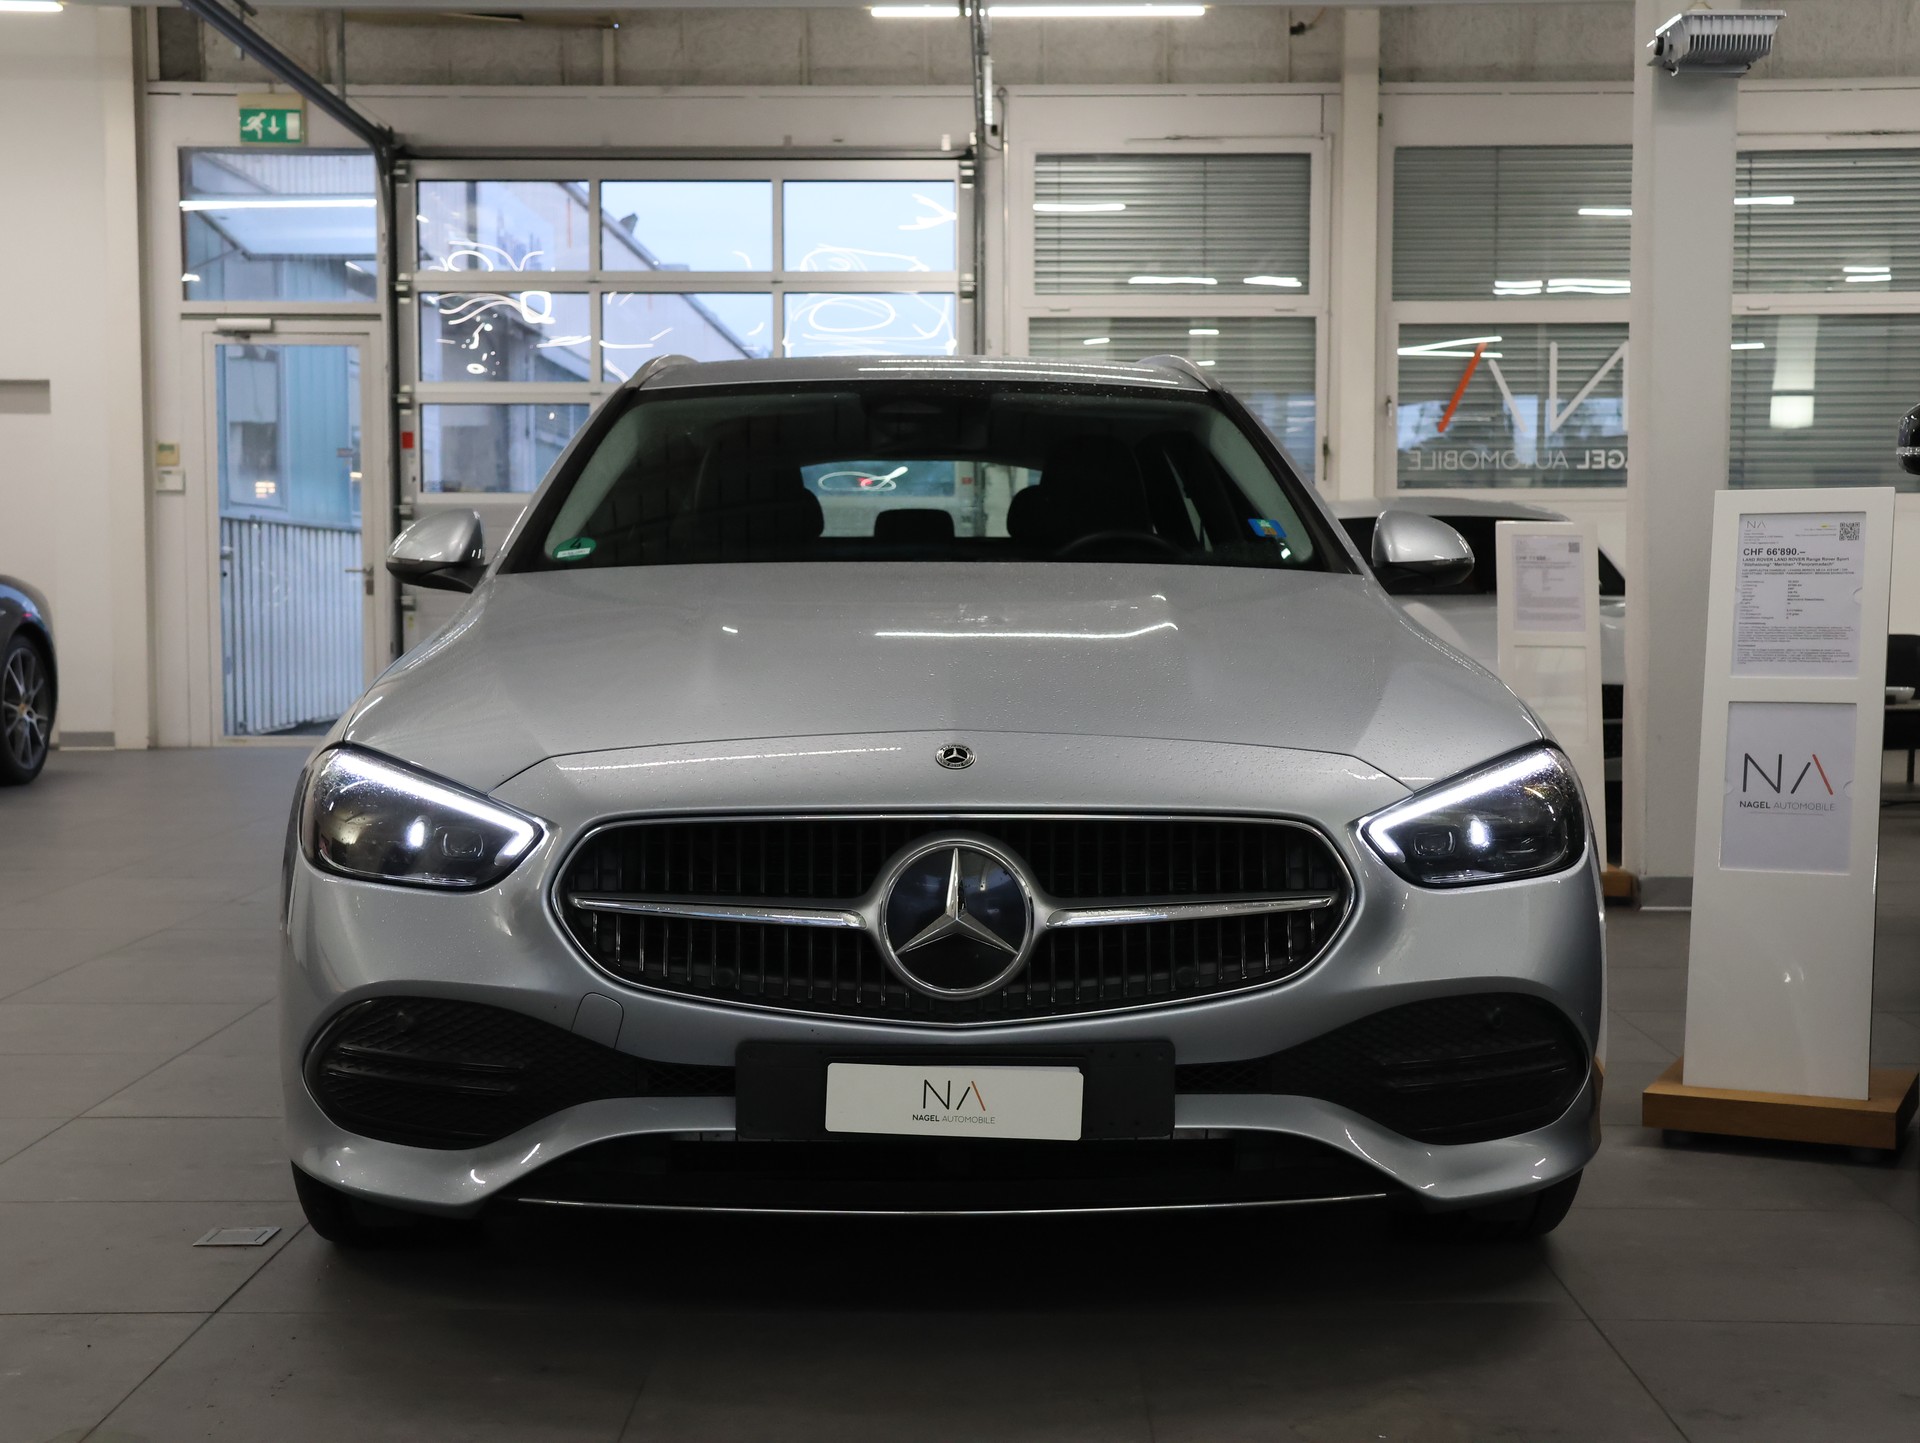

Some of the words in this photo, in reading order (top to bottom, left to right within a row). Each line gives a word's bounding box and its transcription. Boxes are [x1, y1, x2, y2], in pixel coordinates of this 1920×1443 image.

[1746, 520, 1767, 529] NA
[1743, 547, 1764, 556] CHF
[1742, 753, 1834, 795] NA
[1739, 801, 1771, 809] NAGEL
[1773, 801, 1836, 811] AUTOMOBILE
[923, 1079, 986, 1111] NA
[912, 1114, 940, 1122] NAGEL
[942, 1115, 996, 1125] AUTOMOBILE
